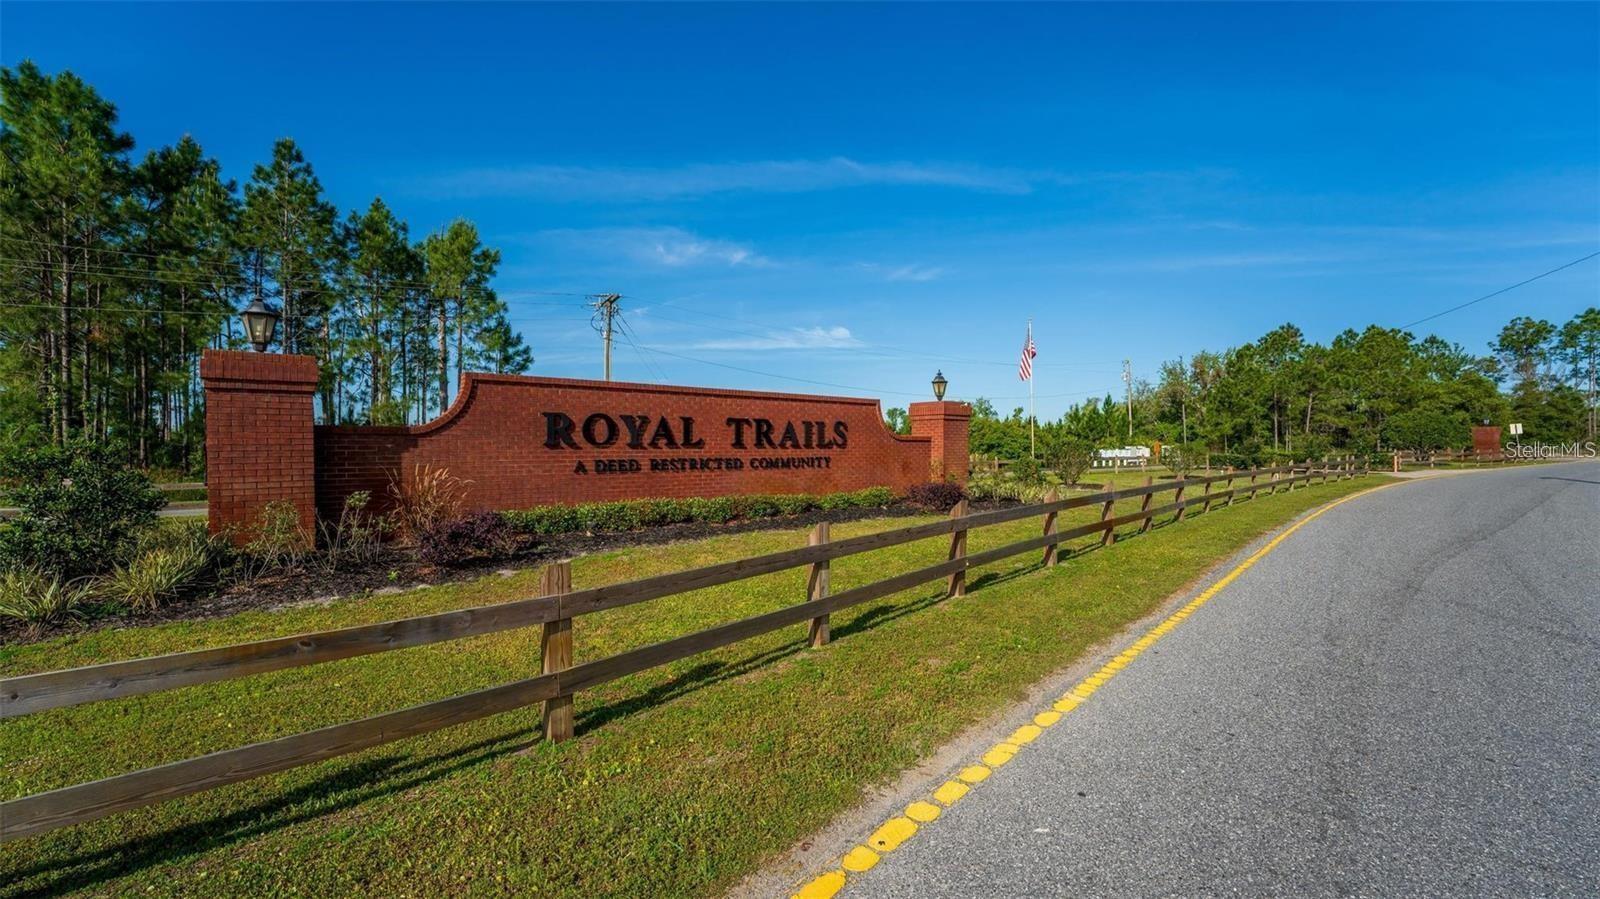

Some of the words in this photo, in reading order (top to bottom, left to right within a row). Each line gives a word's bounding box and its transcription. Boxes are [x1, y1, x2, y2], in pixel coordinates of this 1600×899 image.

[542, 412, 705, 450] ROYAL
[726, 417, 849, 450] TRAILS
[574, 459, 588, 475] A
[594, 459, 641, 474] DEED
[650, 457, 743, 472] RESTRICTED
[750, 455, 832, 470] COMMUNITY
